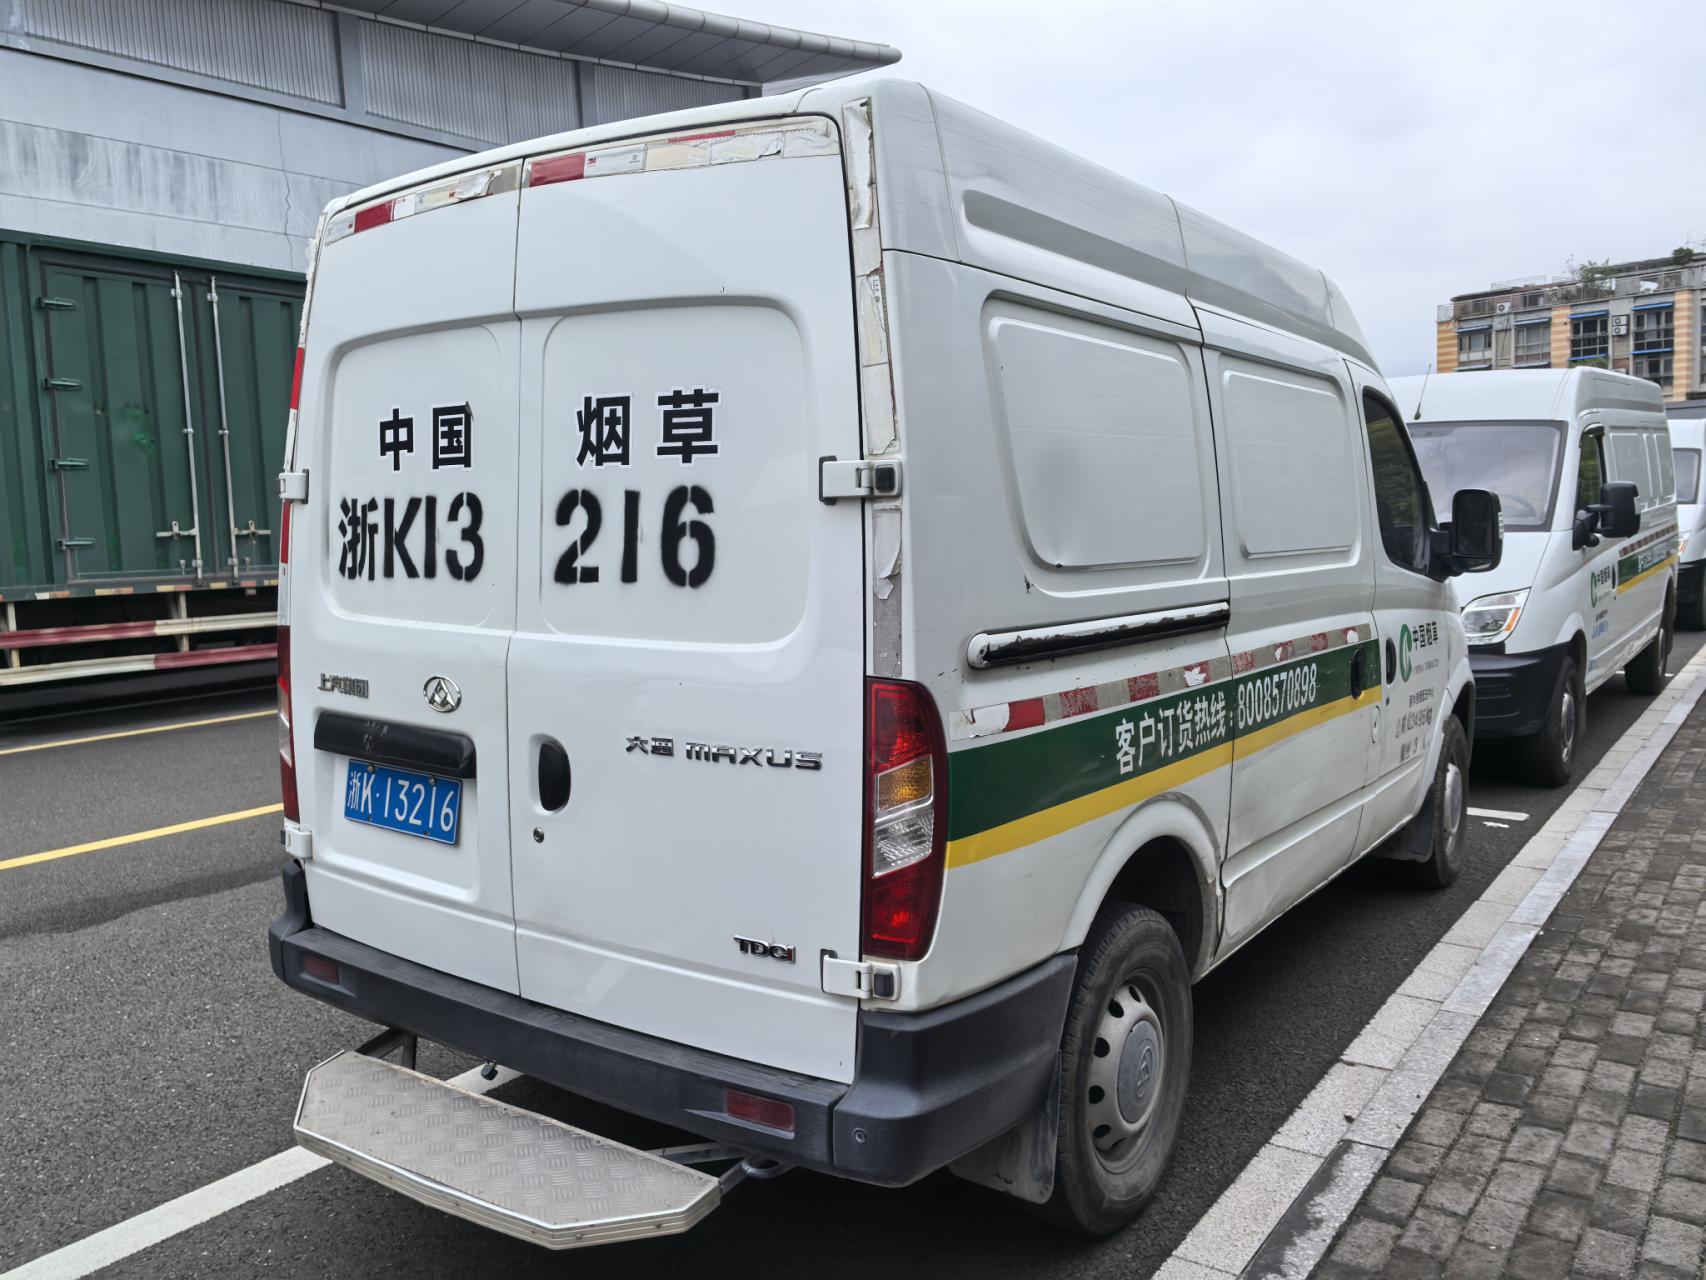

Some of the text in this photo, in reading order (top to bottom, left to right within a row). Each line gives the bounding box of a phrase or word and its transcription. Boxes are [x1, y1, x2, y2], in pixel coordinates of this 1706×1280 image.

[380, 388, 719, 471] 中国 烟草
[338, 485, 715, 589] 浙K13 216
[686, 742, 823, 771] MAXUS
